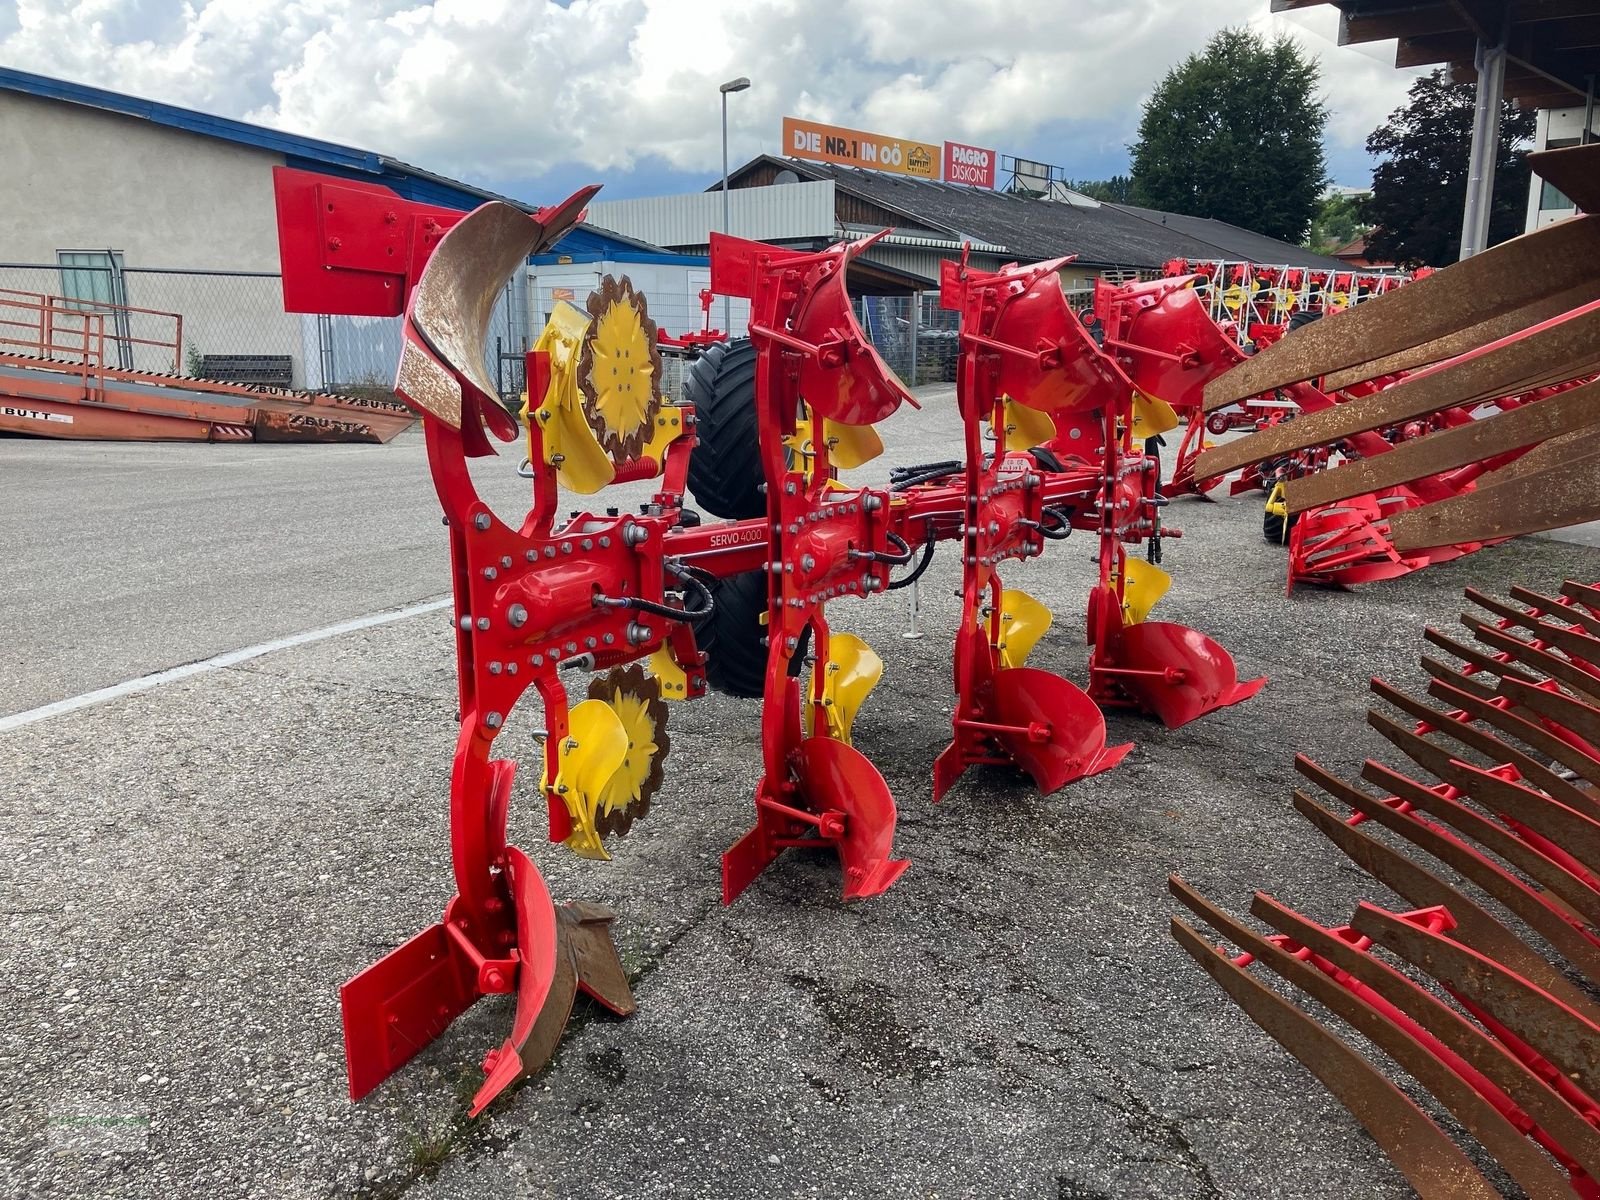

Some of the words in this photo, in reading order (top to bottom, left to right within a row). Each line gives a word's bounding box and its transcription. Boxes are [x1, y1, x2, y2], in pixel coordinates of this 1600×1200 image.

[794, 129, 821, 153] DIE
[861, 142, 877, 162] IN
[880, 143, 902, 166] OÖ
[952, 146, 989, 168] PAGRO
[951, 163, 988, 184] DISKONT
[259, 386, 297, 398] BUTT
[5, 407, 51, 420] BUTT
[360, 399, 399, 411] BUTT
[710, 532, 739, 547] SERVO
[740, 529, 762, 542] 4000
